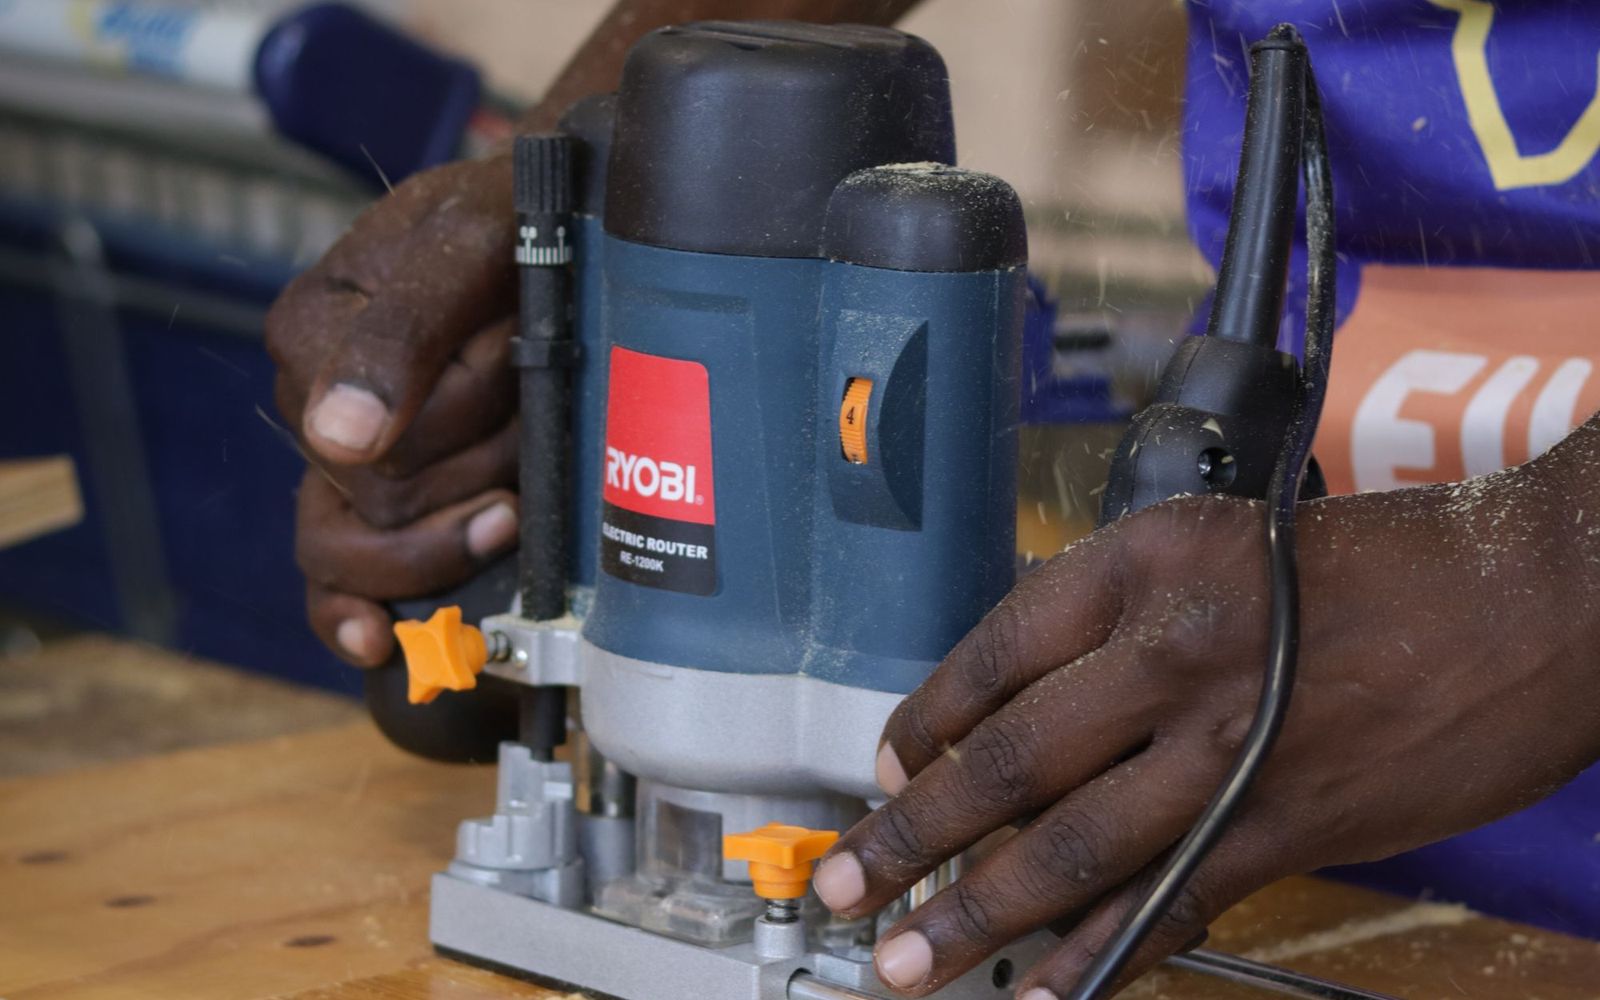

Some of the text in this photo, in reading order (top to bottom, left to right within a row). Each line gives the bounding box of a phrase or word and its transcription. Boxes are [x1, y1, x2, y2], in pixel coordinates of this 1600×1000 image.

[846, 406, 856, 425] 4
[607, 446, 697, 504] RYOBI
[602, 522, 708, 559] ELECTRIC ROUTER
